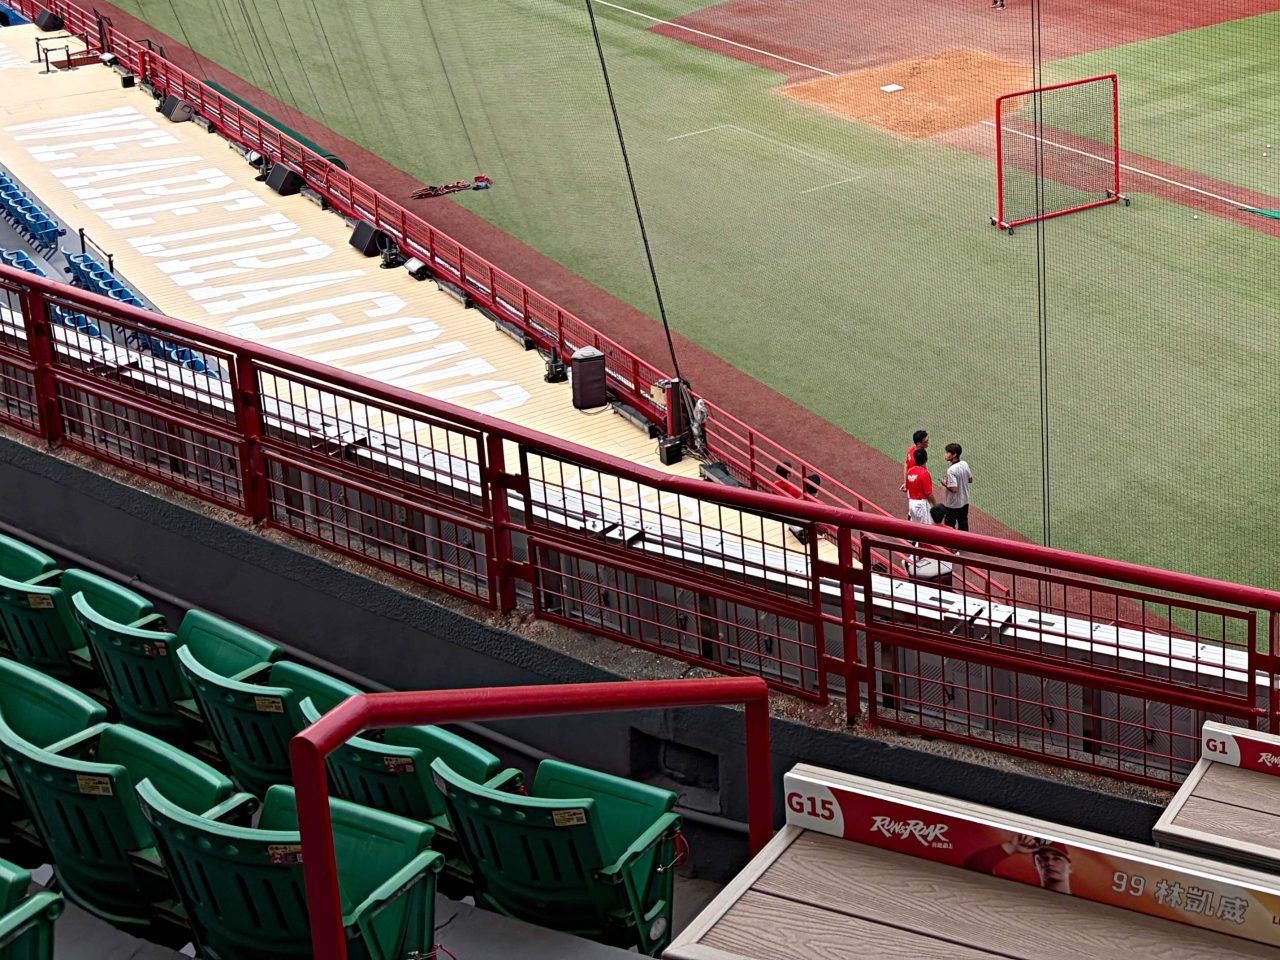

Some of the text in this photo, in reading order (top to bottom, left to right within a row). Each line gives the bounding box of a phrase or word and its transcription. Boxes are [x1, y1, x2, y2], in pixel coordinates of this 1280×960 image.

[1205, 738, 1228, 755] G1
[787, 792, 835, 821] G15
[1112, 872, 1146, 898] 99
[1154, 882, 1250, 924] 林凱威
